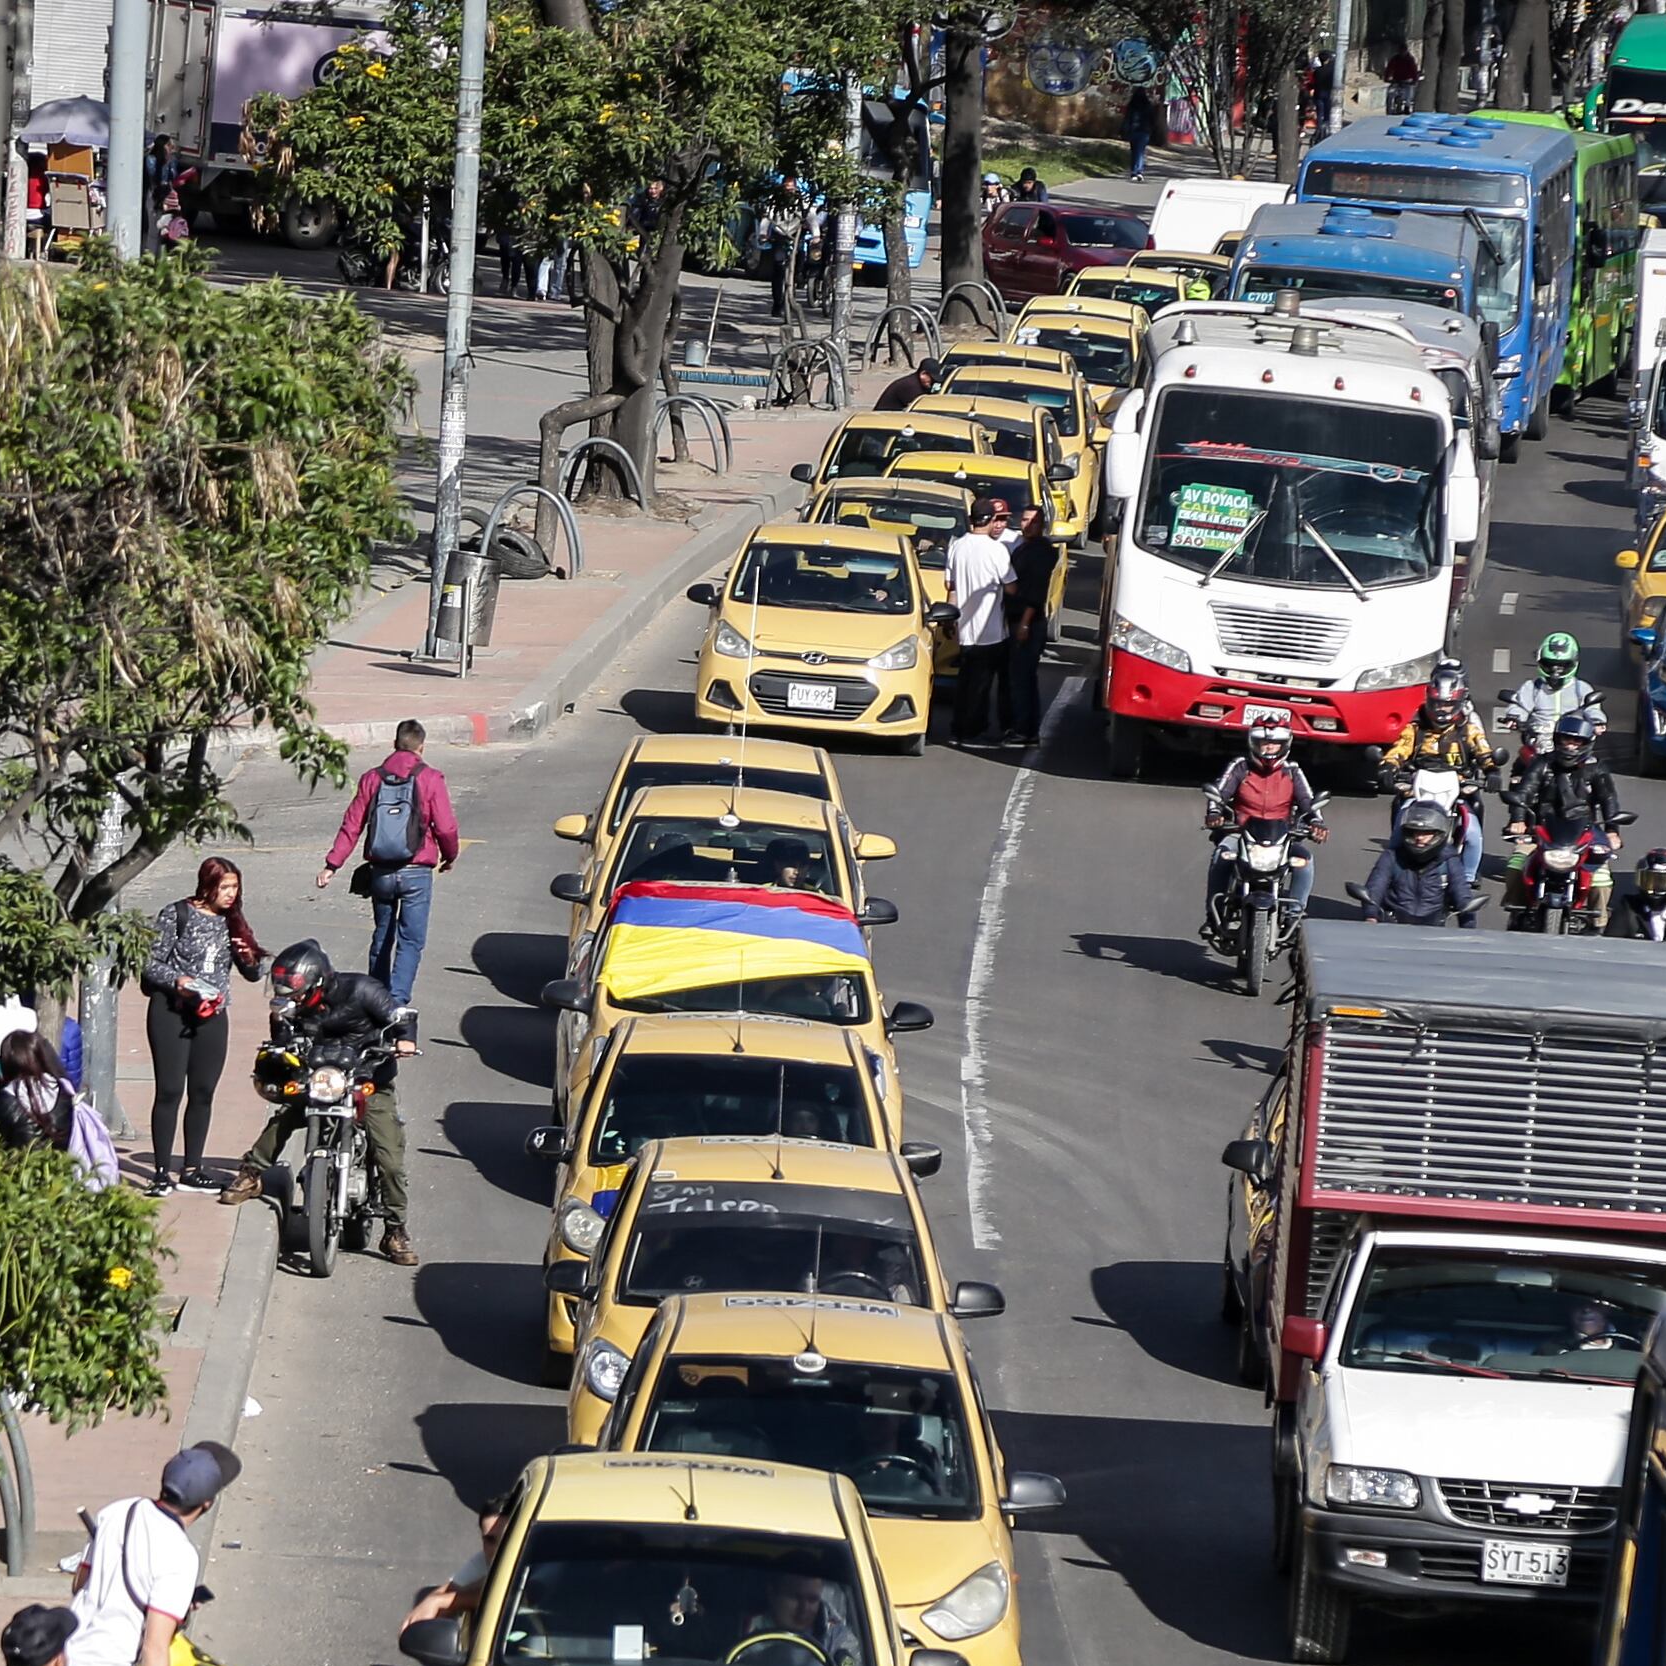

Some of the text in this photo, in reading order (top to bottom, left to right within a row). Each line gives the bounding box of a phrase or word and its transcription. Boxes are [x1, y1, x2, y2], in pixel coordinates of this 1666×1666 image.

[1183, 488, 1202, 503] AV
[1202, 491, 1249, 510] BOYACA
[1486, 1548, 1569, 1576] SYT-513
